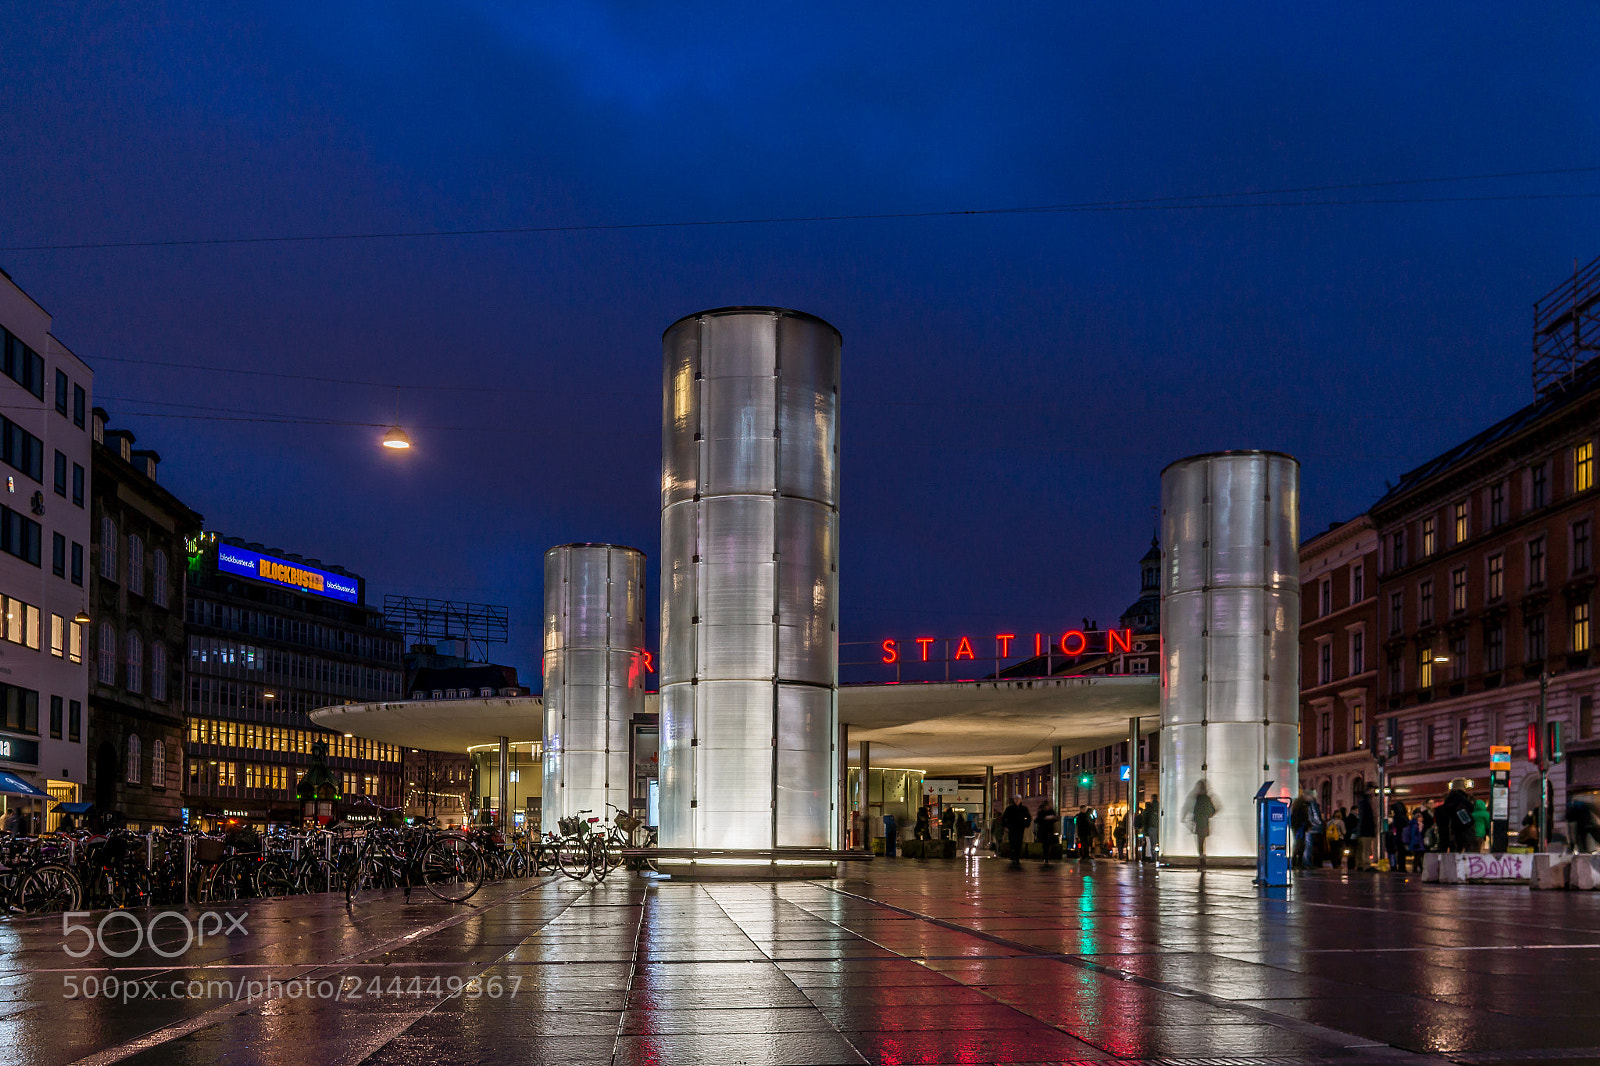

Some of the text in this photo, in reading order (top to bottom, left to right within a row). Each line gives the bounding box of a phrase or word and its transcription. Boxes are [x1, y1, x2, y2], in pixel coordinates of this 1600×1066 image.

[219, 552, 255, 569] blockbuster.dk
[259, 558, 325, 592] BLOCKBUSTER
[326, 580, 356, 595] blockbuster.dk
[881, 628, 1133, 665] STATION
